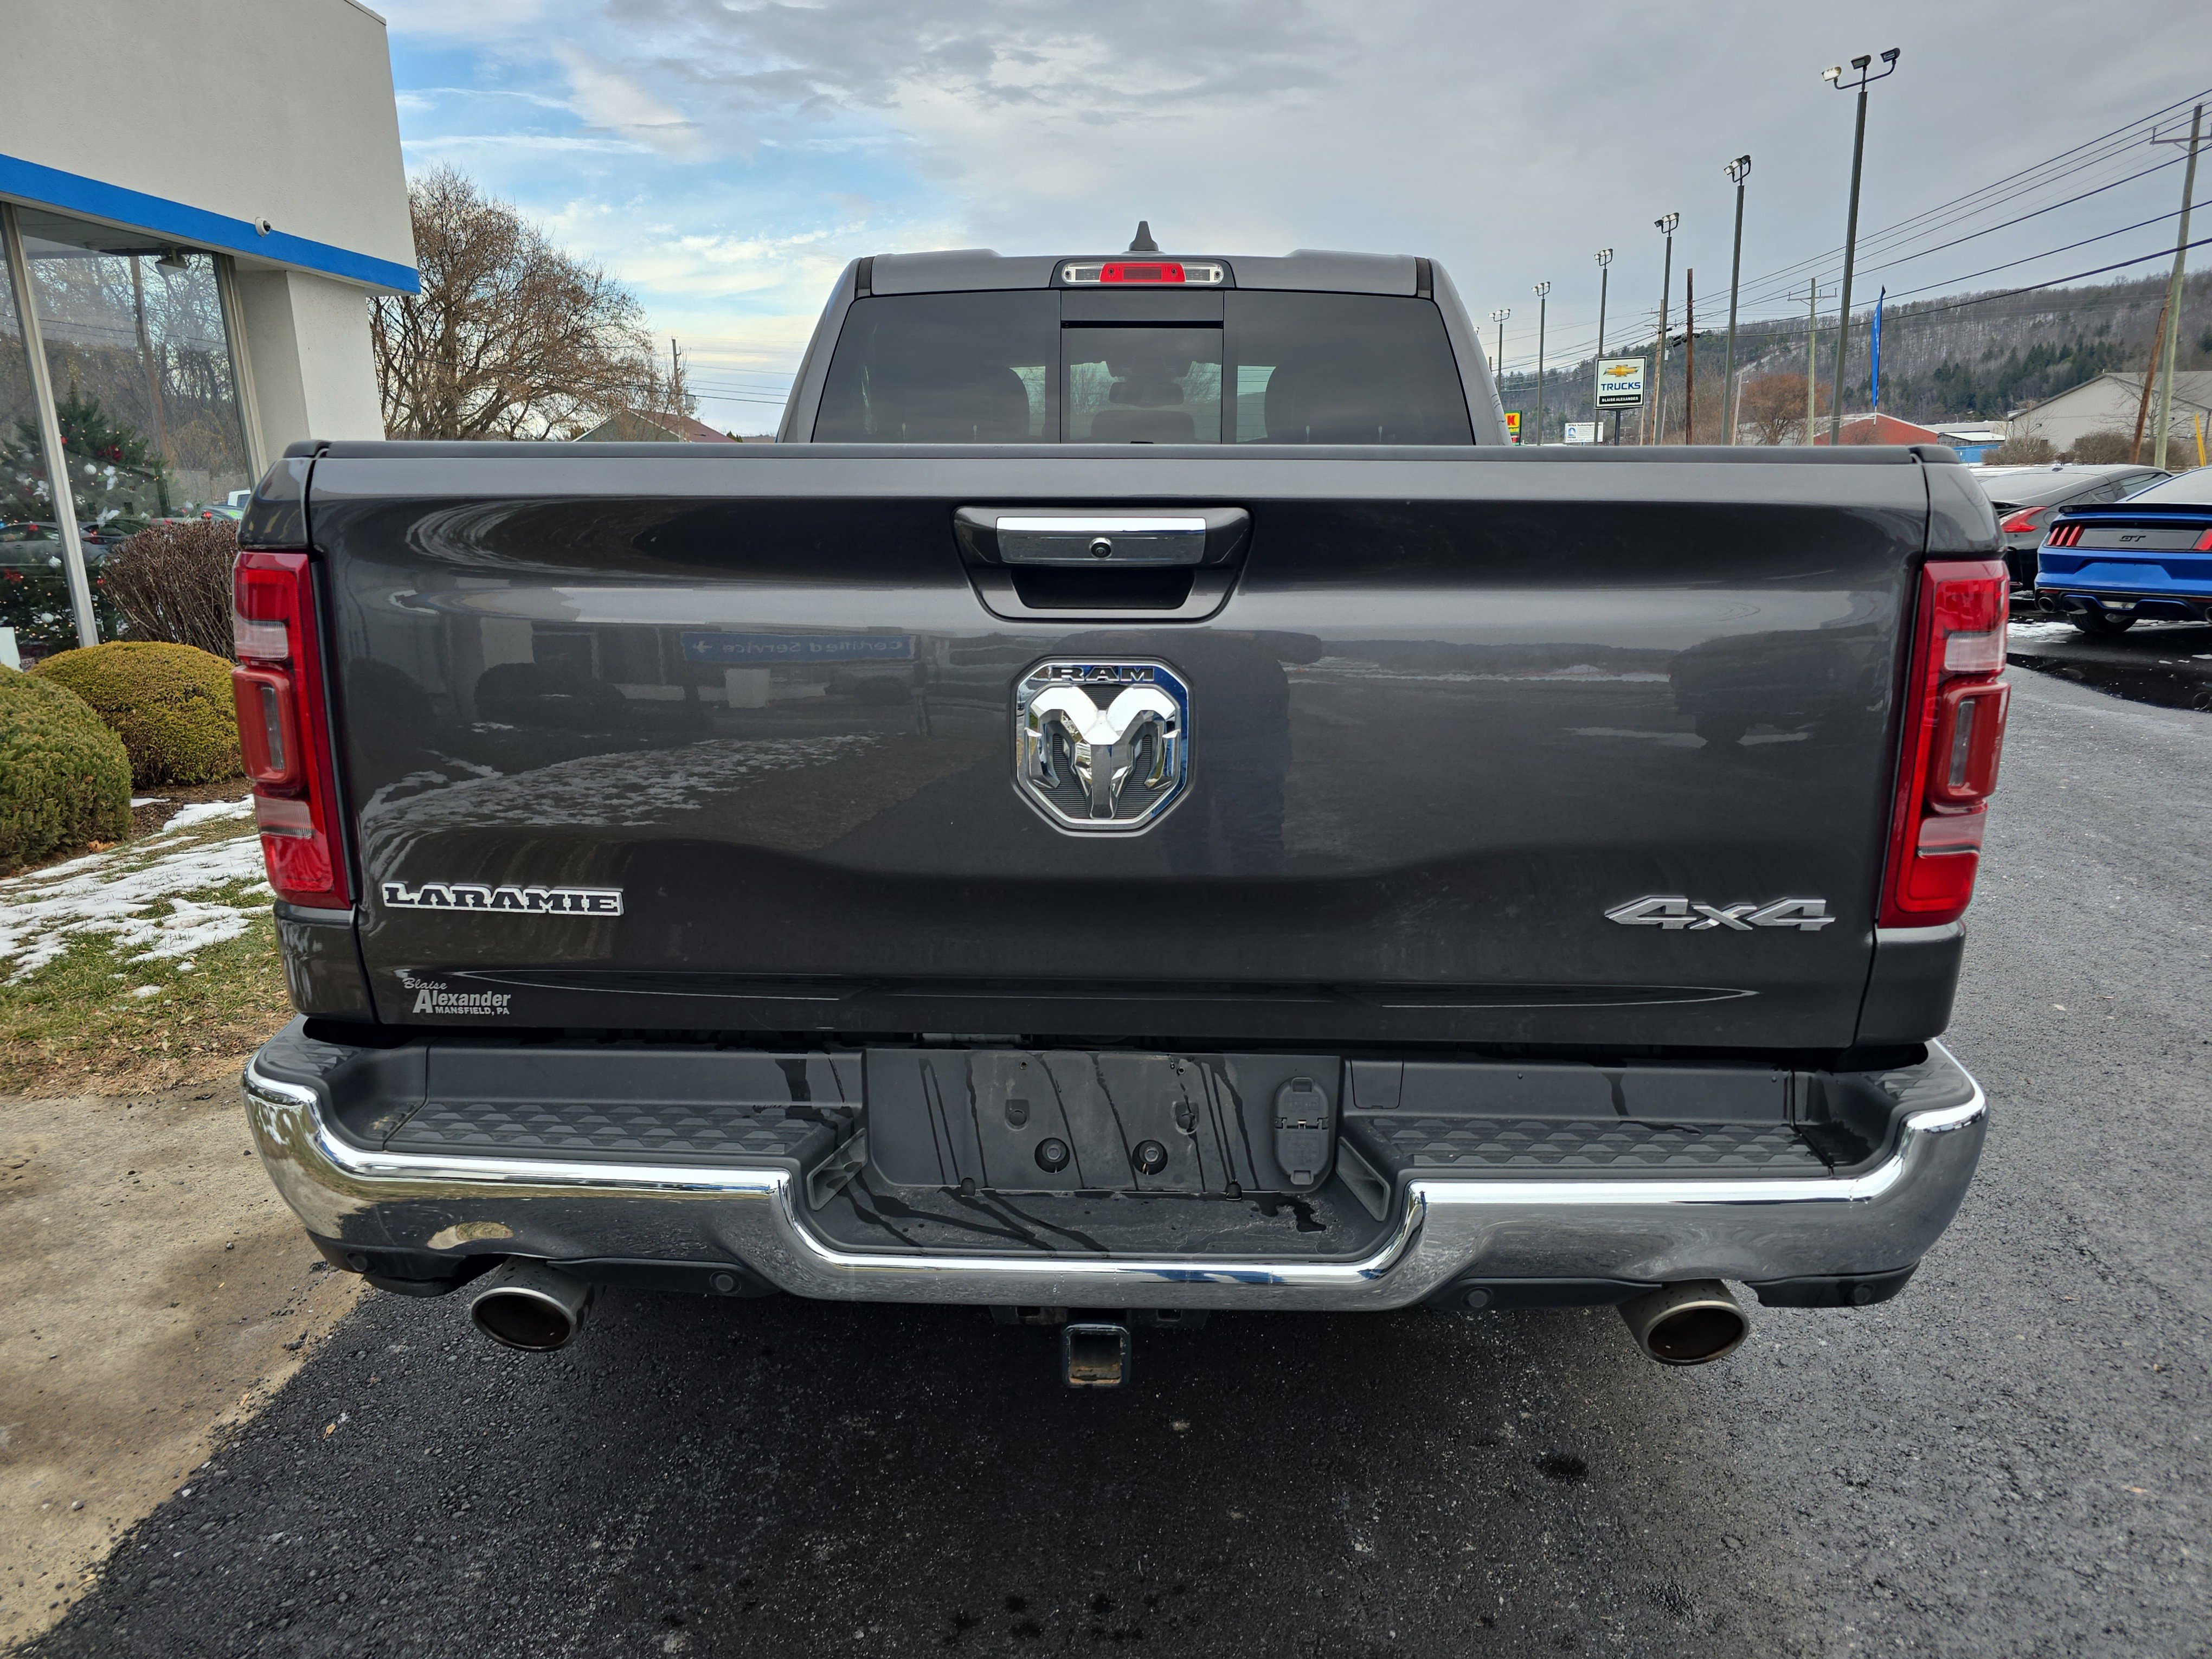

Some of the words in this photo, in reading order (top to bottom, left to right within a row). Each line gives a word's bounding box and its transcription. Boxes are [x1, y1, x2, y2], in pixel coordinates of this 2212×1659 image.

[1601, 382, 1641, 391] TRUCKS
[1050, 666, 1154, 682] RAM
[382, 882, 623, 916] LARAMIE
[402, 978, 448, 989] Blaise
[413, 989, 511, 1013] Alexander
[435, 1007, 494, 1016] MANSFIELD,
